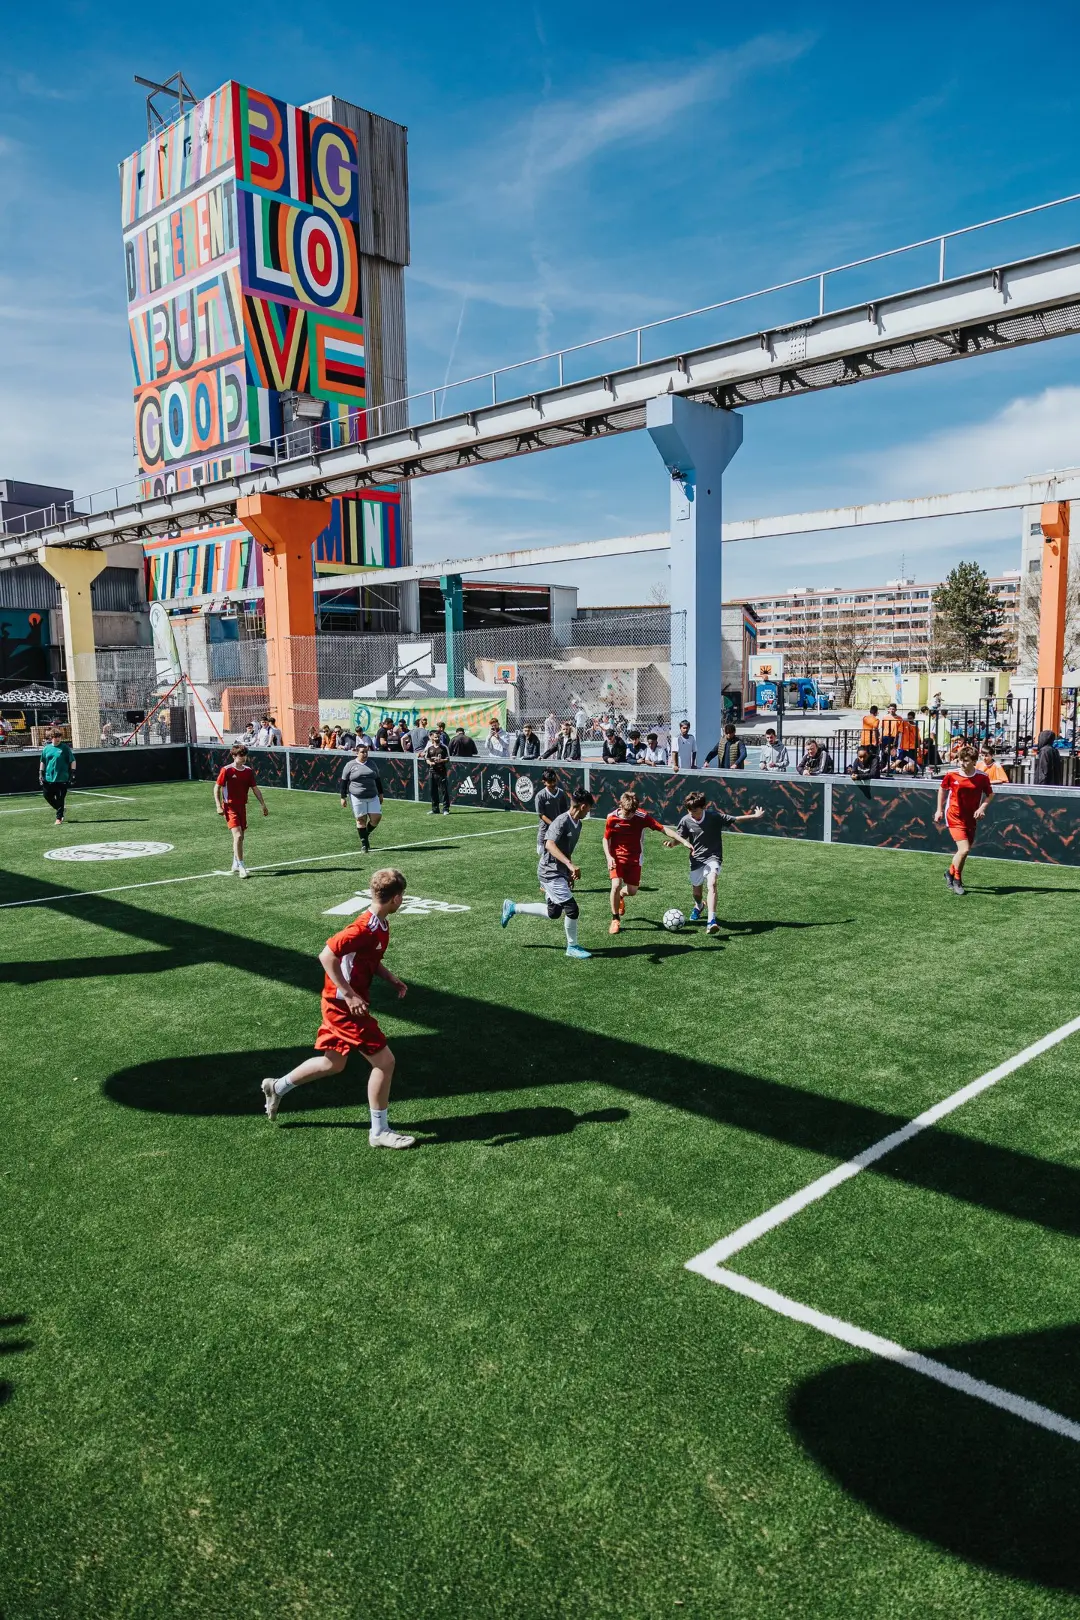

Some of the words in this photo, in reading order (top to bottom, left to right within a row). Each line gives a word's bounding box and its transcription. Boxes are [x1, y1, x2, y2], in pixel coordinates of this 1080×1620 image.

[234, 84, 358, 214] BIG
[124, 182, 236, 302] DIFFERENT
[136, 364, 248, 475] GOOD
[317, 498, 397, 566] MINI
[459, 787, 478, 795] adidas
